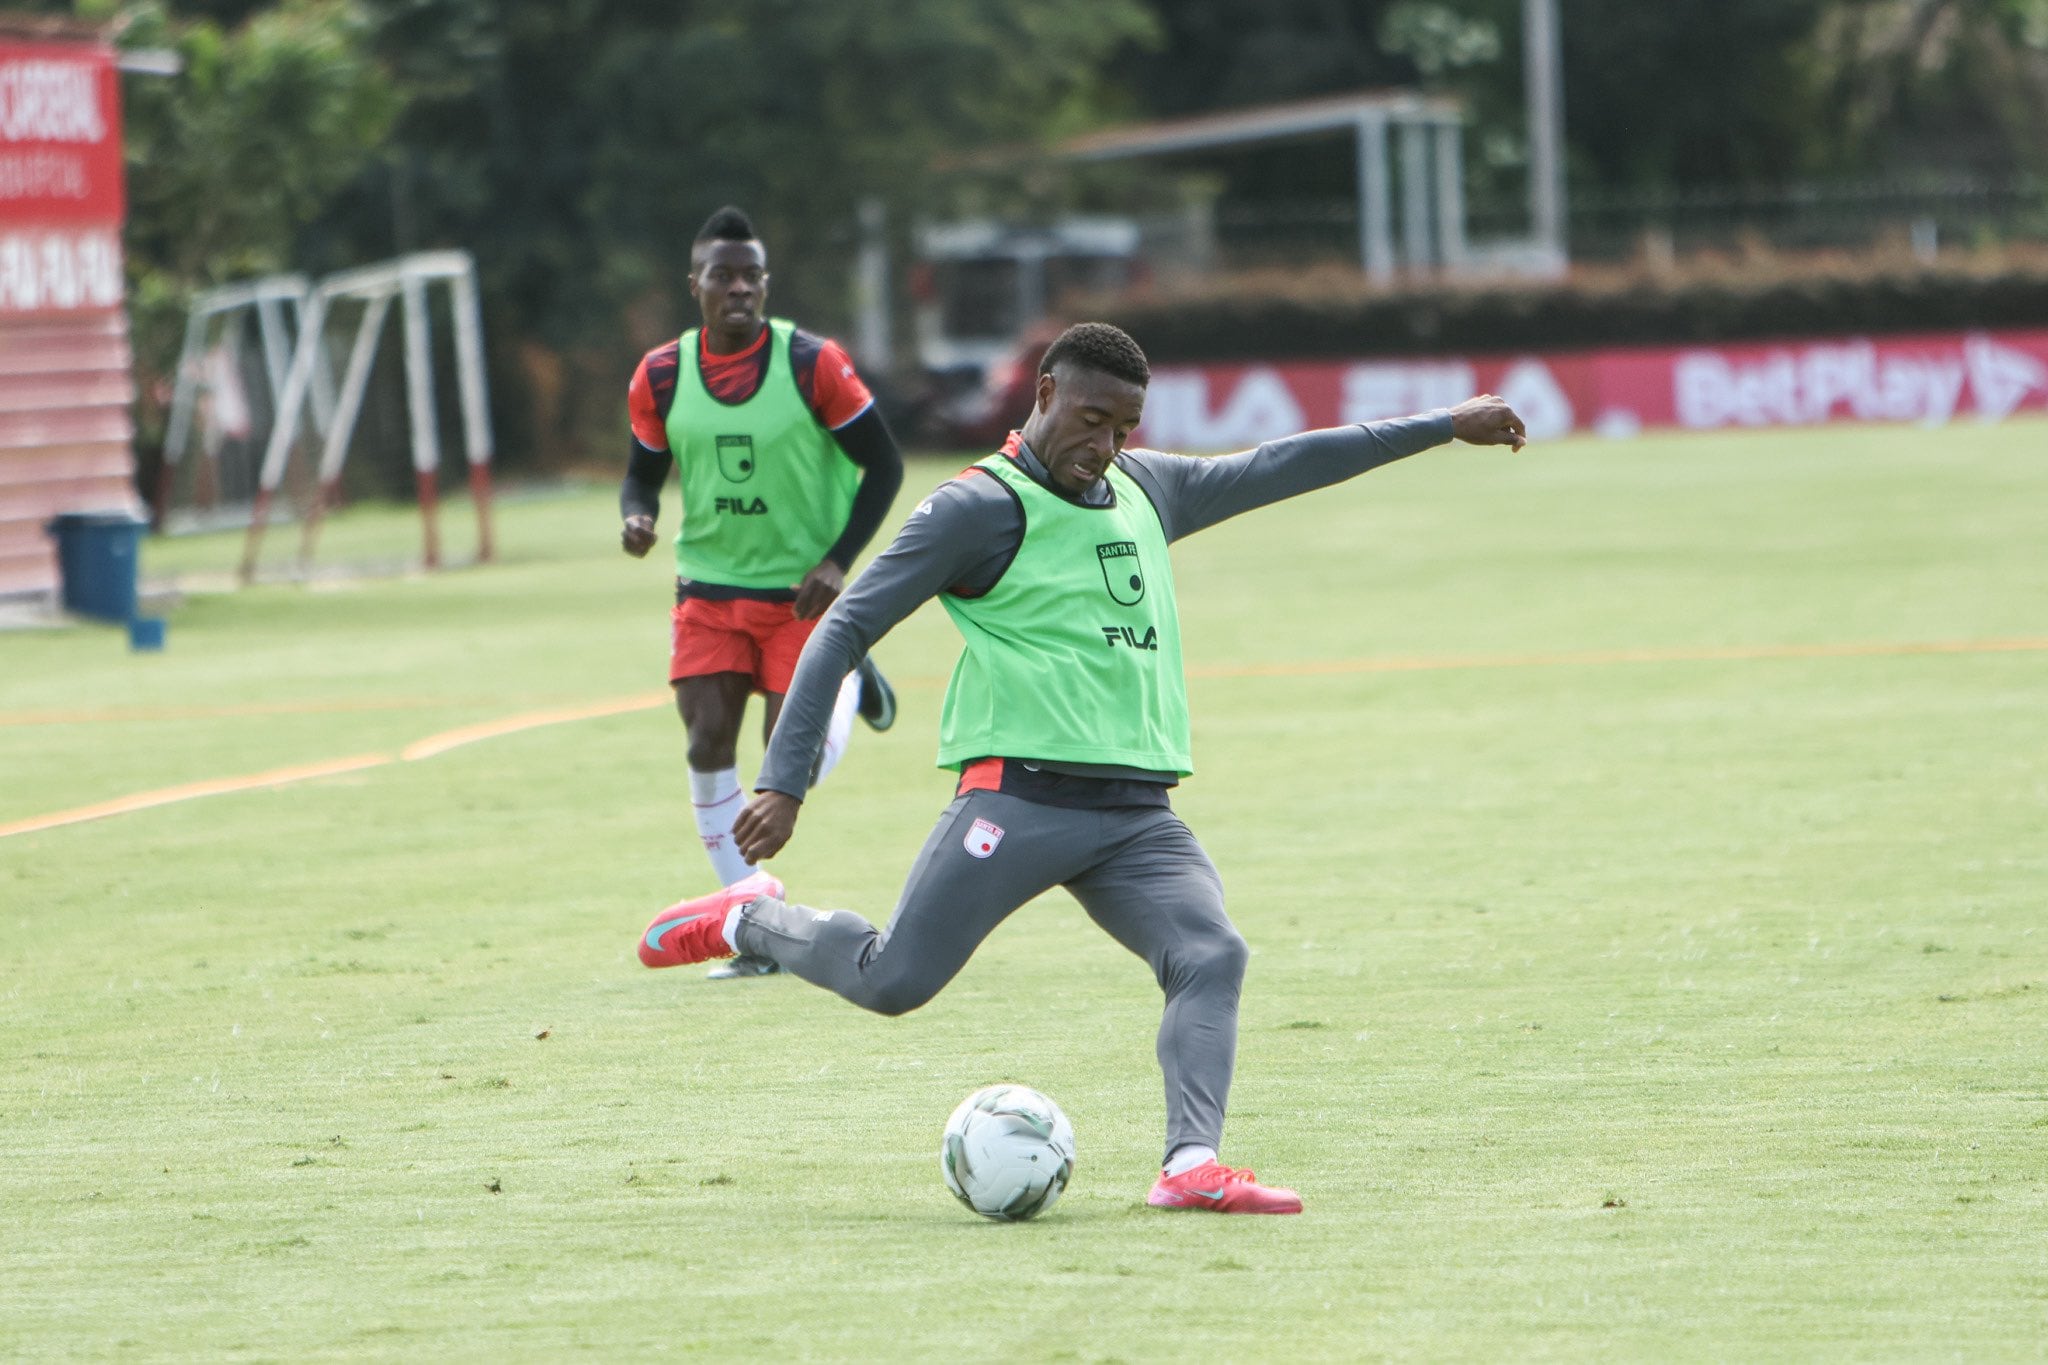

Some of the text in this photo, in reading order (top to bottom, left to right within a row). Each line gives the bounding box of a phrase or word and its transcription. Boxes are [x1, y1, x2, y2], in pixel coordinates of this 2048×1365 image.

[1673, 335, 1965, 430] BetPlay
[715, 497, 768, 515] FILA
[1099, 544, 1137, 558] SANTA FE
[1102, 626, 1157, 650] FILA
